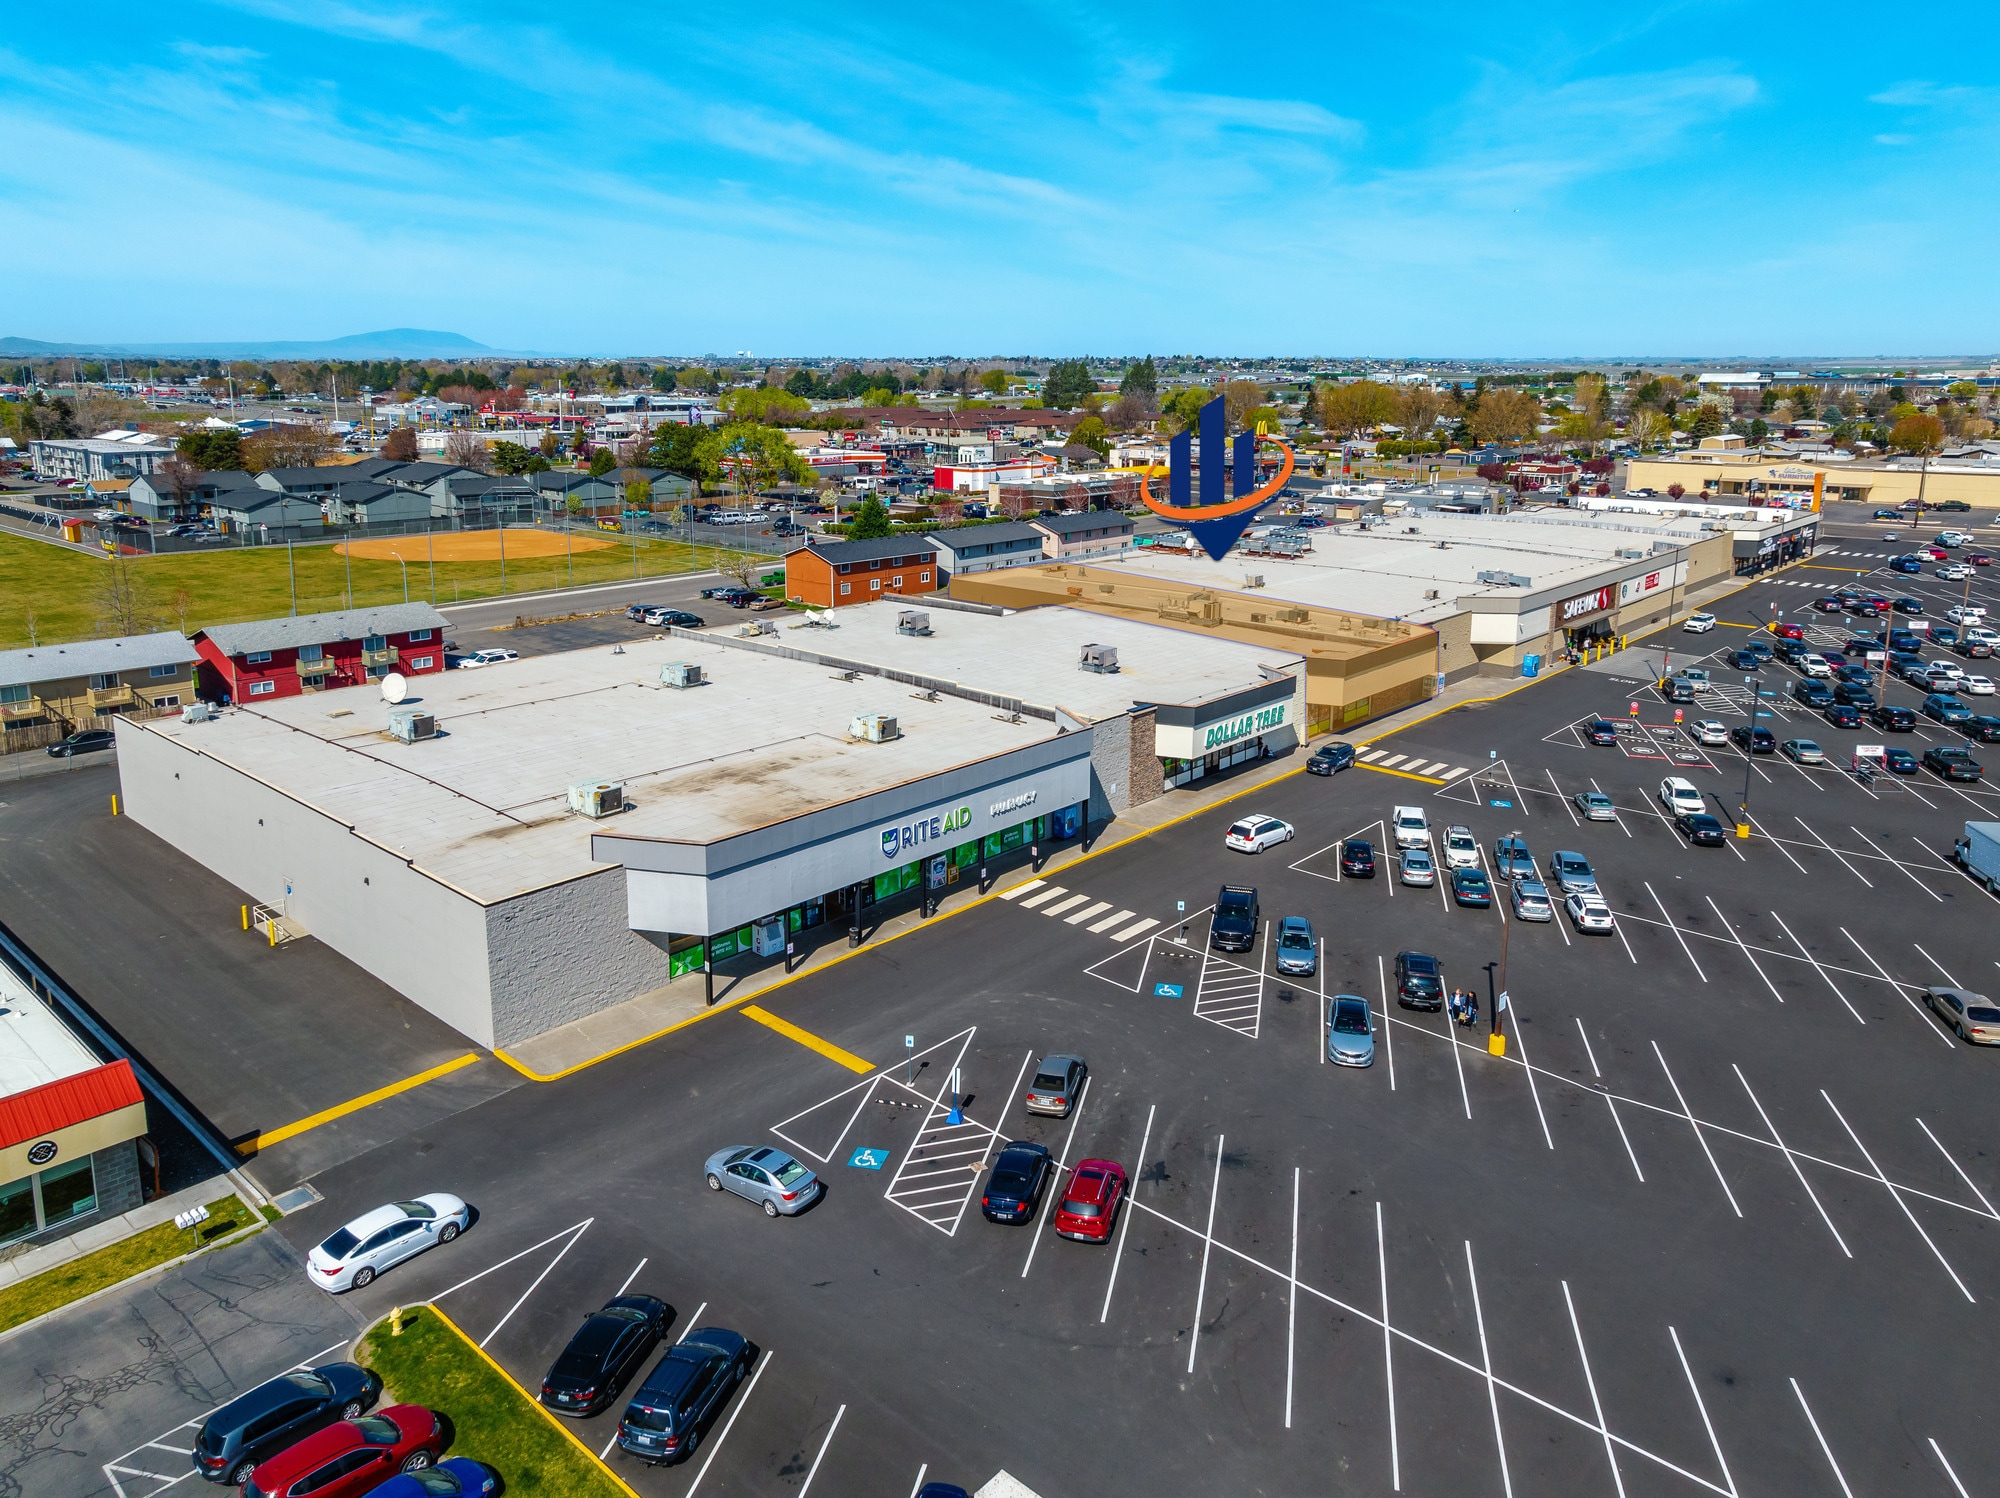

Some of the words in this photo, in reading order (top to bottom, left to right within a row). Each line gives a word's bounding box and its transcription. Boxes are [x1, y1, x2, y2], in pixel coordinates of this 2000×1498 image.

[1563, 592, 1602, 619] SAFEWAY
[1205, 715, 1253, 747] DOLLAR
[1256, 705, 1285, 728] TREE
[900, 816, 940, 848] RITE
[942, 806, 972, 833] AID
